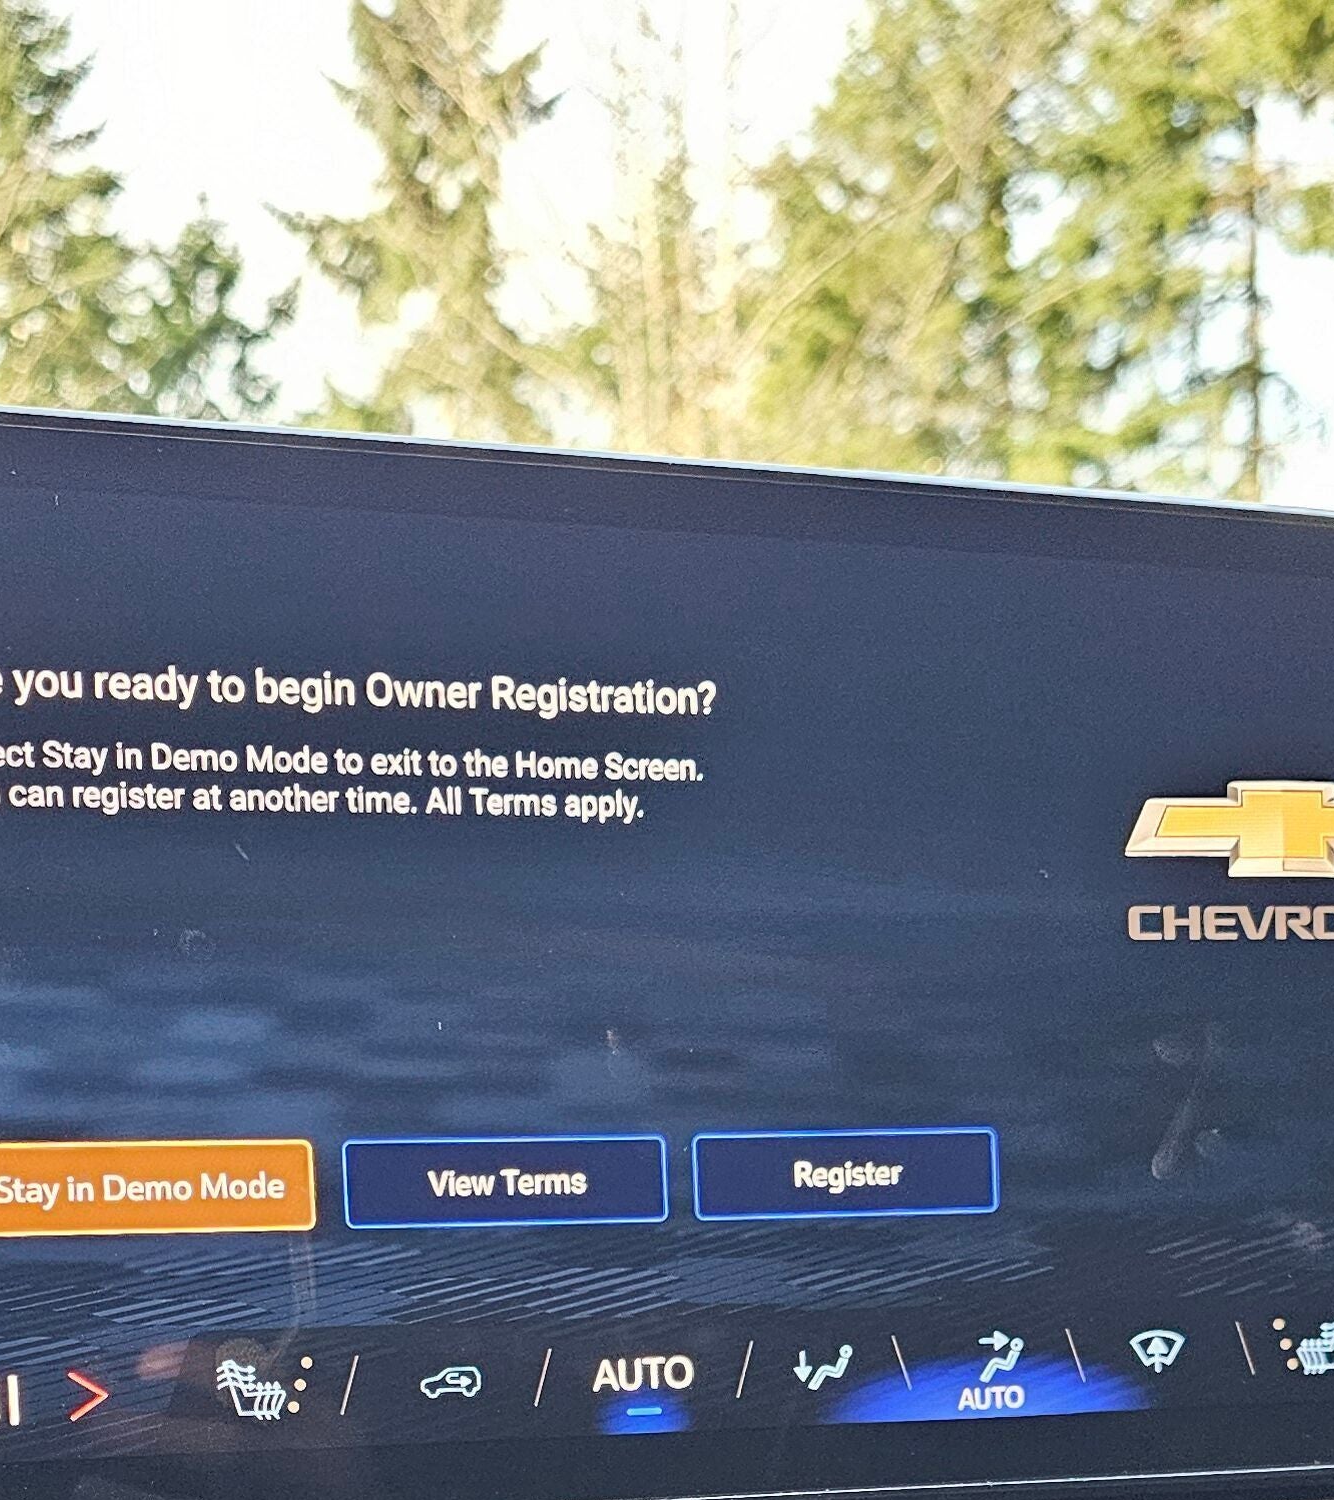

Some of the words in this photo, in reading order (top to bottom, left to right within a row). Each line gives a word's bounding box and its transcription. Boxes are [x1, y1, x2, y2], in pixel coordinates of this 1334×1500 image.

[11, 669, 83, 706] you
[94, 664, 199, 710] ready
[205, 669, 246, 703] to
[254, 666, 356, 714] begin
[366, 671, 483, 709] Owner
[491, 675, 717, 720] Registration?
[42, 739, 109, 776] Stay
[115, 741, 143, 770] in
[150, 742, 238, 772] Demo
[245, 744, 328, 774] Mode
[333, 748, 364, 775] to
[370, 747, 423, 777] exit
[427, 750, 458, 777] to
[462, 748, 509, 778] the
[515, 750, 599, 780] Home
[604, 751, 704, 782] Screen.
[8, 784, 65, 808] can
[72, 781, 186, 815] register
[192, 784, 223, 812] at
[229, 782, 340, 813] another
[344, 785, 418, 815] time.
[425, 785, 462, 815] All
[468, 787, 558, 817] Terms
[564, 788, 645, 825] apply.
[66, 1175, 95, 1202] in
[102, 1174, 193, 1202] Demo
[200, 1170, 285, 1200] Mode
[427, 1169, 496, 1197] View
[499, 1168, 588, 1196] Terms
[793, 1160, 904, 1194] Register
[592, 1354, 695, 1393] AUTO
[957, 1382, 1025, 1411] AUTO
